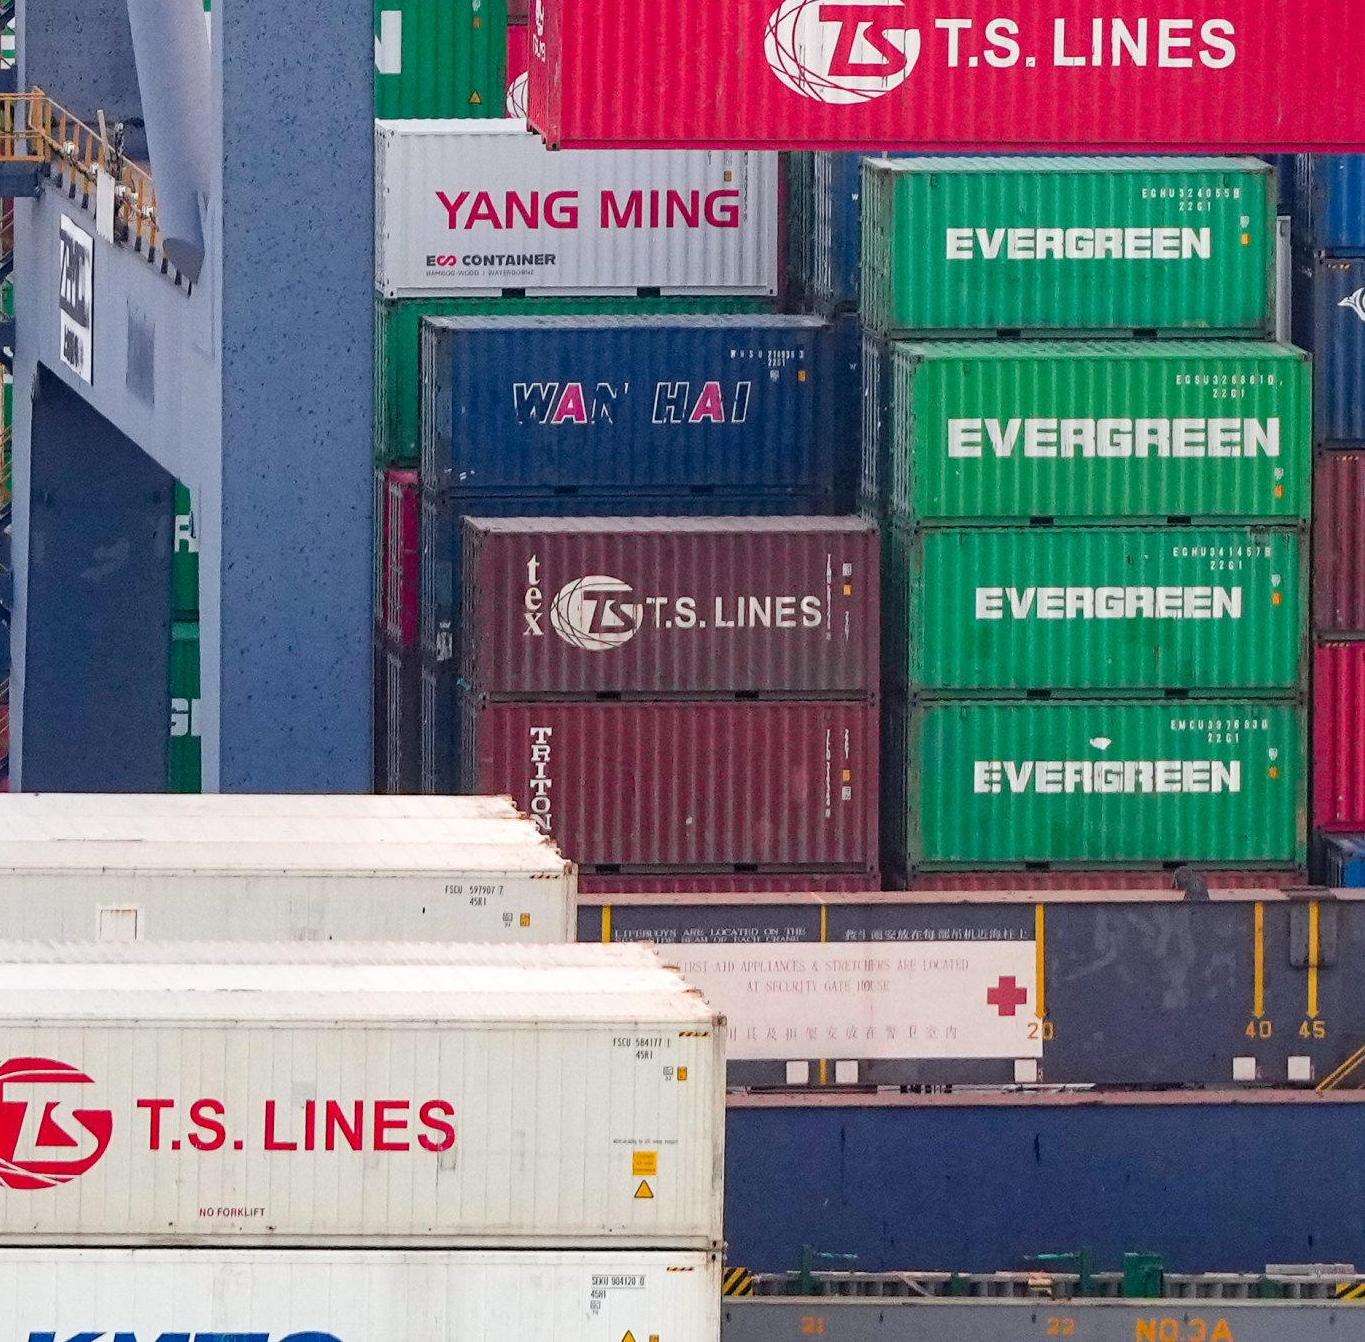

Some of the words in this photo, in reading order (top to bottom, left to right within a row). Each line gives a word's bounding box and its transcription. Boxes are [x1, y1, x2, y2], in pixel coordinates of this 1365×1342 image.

[935, 17, 1037, 69] T.S.
[1053, 17, 1239, 70] LINES
[434, 190, 579, 230] YANG
[600, 188, 740, 229] MING
[1179, 201, 1211, 212] 22G1
[945, 227, 1211, 260] EVERGREEN
[462, 253, 556, 266] CONTAINER
[651, 381, 751, 424] HAI
[1212, 388, 1244, 399] 22G1
[947, 416, 1280, 458] EVERGREEN
[1210, 560, 1242, 571] 22G1
[523, 554, 544, 636] tex
[975, 585, 1242, 620] EVERGREEN
[645, 596, 707, 630] T.S.
[714, 596, 823, 630] LINES
[530, 727, 553, 832] TRITON
[973, 760, 1241, 794] EVERGREEN
[445, 885, 463, 894] FSCU
[469, 885, 495, 894] 597907
[469, 897, 487, 906] 45R1
[615, 928, 677, 938] LIFEBUOYS
[683, 928, 704, 938] ARE
[710, 928, 760, 938] LOCATED
[764, 927, 779, 938] ON
[784, 927, 807, 938] THE
[715, 960, 735, 972] AID
[740, 960, 807, 972] APPLIANCES
[824, 959, 891, 971] STRETCHERS
[896, 959, 917, 971] ARE
[922, 959, 970, 971] LOCATED
[746, 981, 760, 993] AT
[765, 980, 818, 993] SECURITY
[824, 980, 851, 993] GATE
[857, 980, 890, 992] HOUSE
[1027, 1021, 1055, 1039] 20
[1245, 1020, 1274, 1039] 40
[1298, 1020, 1327, 1039] 45
[635, 1037, 662, 1048] 584177
[635, 1052, 653, 1062] 45R1
[136, 1097, 244, 1152] T.S.
[263, 1097, 457, 1153] LINES
[199, 1208, 214, 1217] NO
[217, 1208, 266, 1217] FORKLIFT
[591, 1276, 609, 1286] SEKU
[611, 1276, 636, 1286] 904120
[1046, 1316, 1078, 1335] 22
[1135, 1317, 1235, 1342] NO.3A
